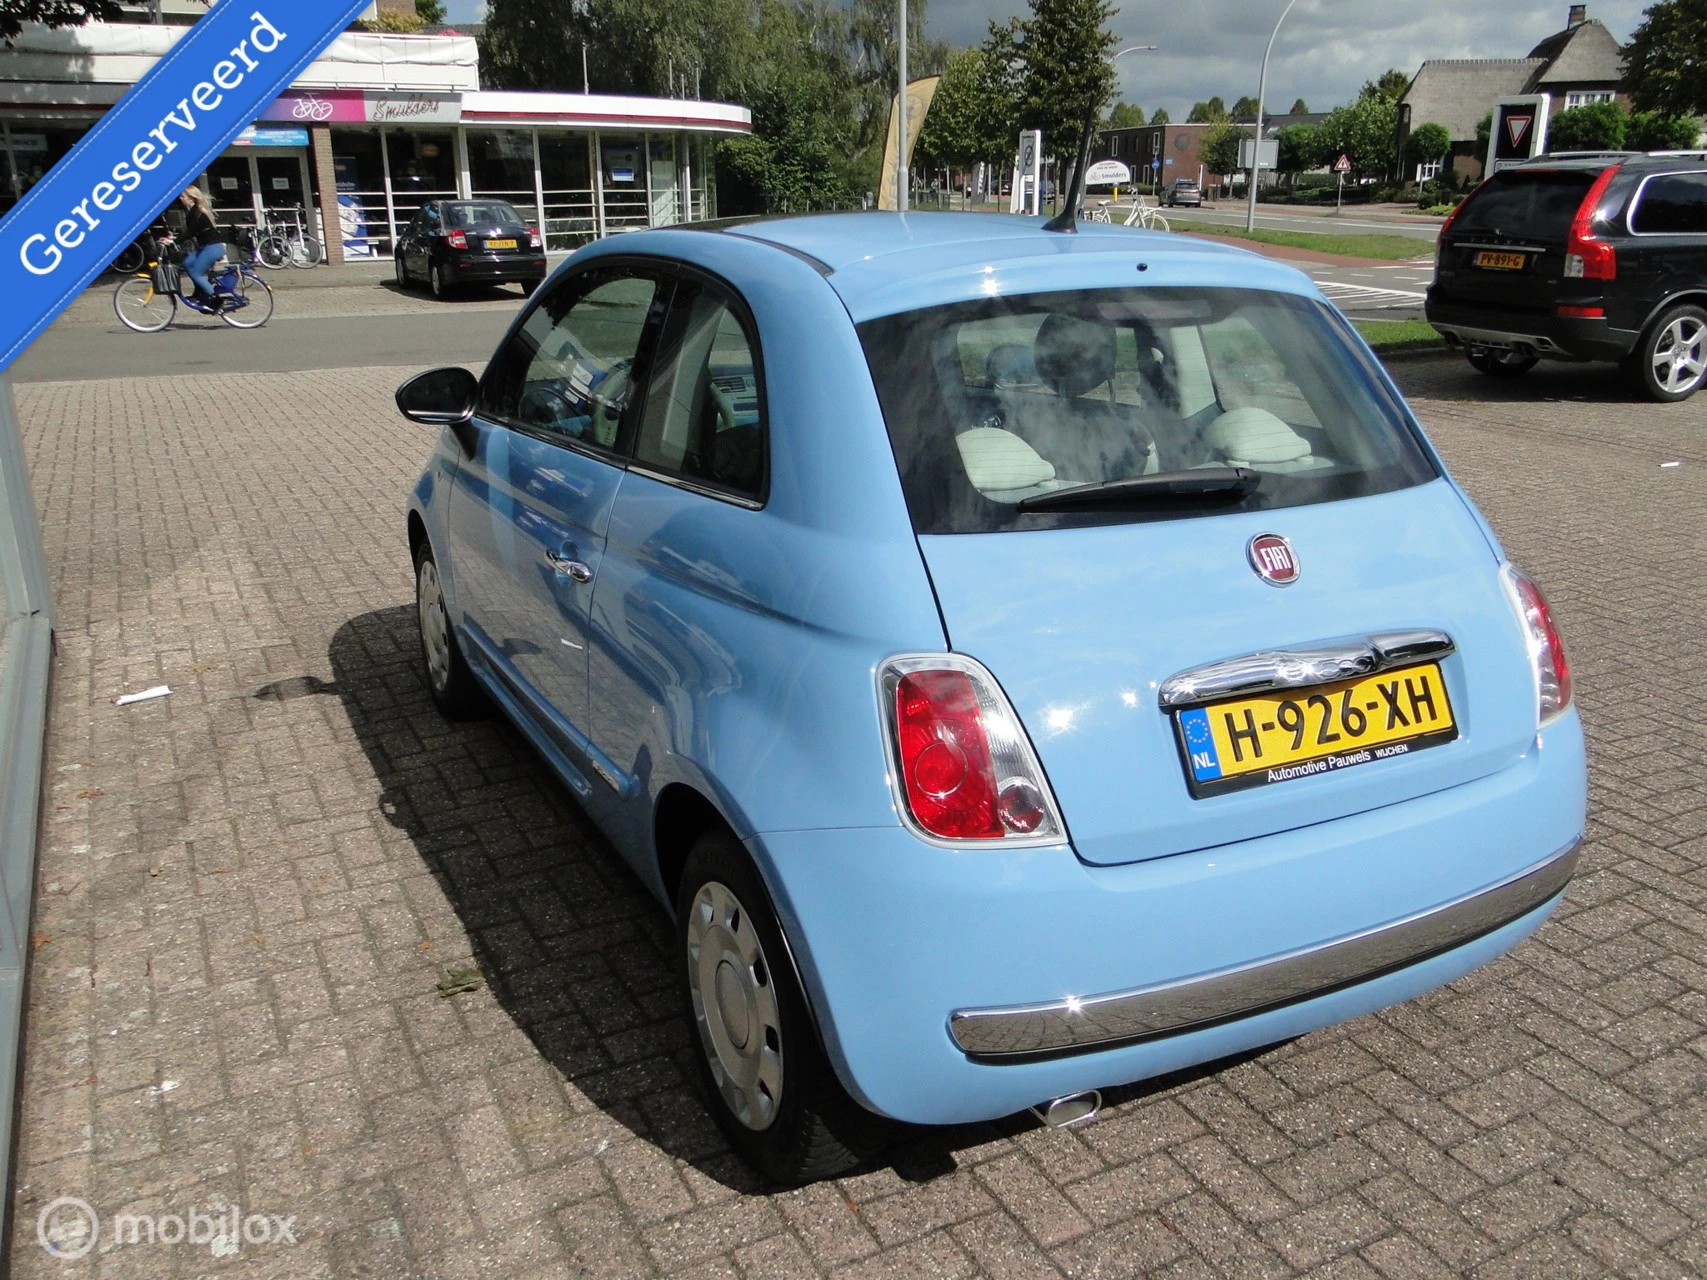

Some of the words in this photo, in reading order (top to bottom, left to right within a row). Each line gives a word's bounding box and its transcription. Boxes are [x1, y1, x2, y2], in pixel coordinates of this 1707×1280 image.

[372, 93, 441, 122] Smulders
[1480, 253, 1521, 267] PV-891-G
[1260, 545, 1291, 572] FIAT
[1193, 751, 1216, 770] NL
[1224, 675, 1438, 763] H-926-XH
[1267, 760, 1327, 783] Automotive
[1327, 749, 1371, 770] Pauwels
